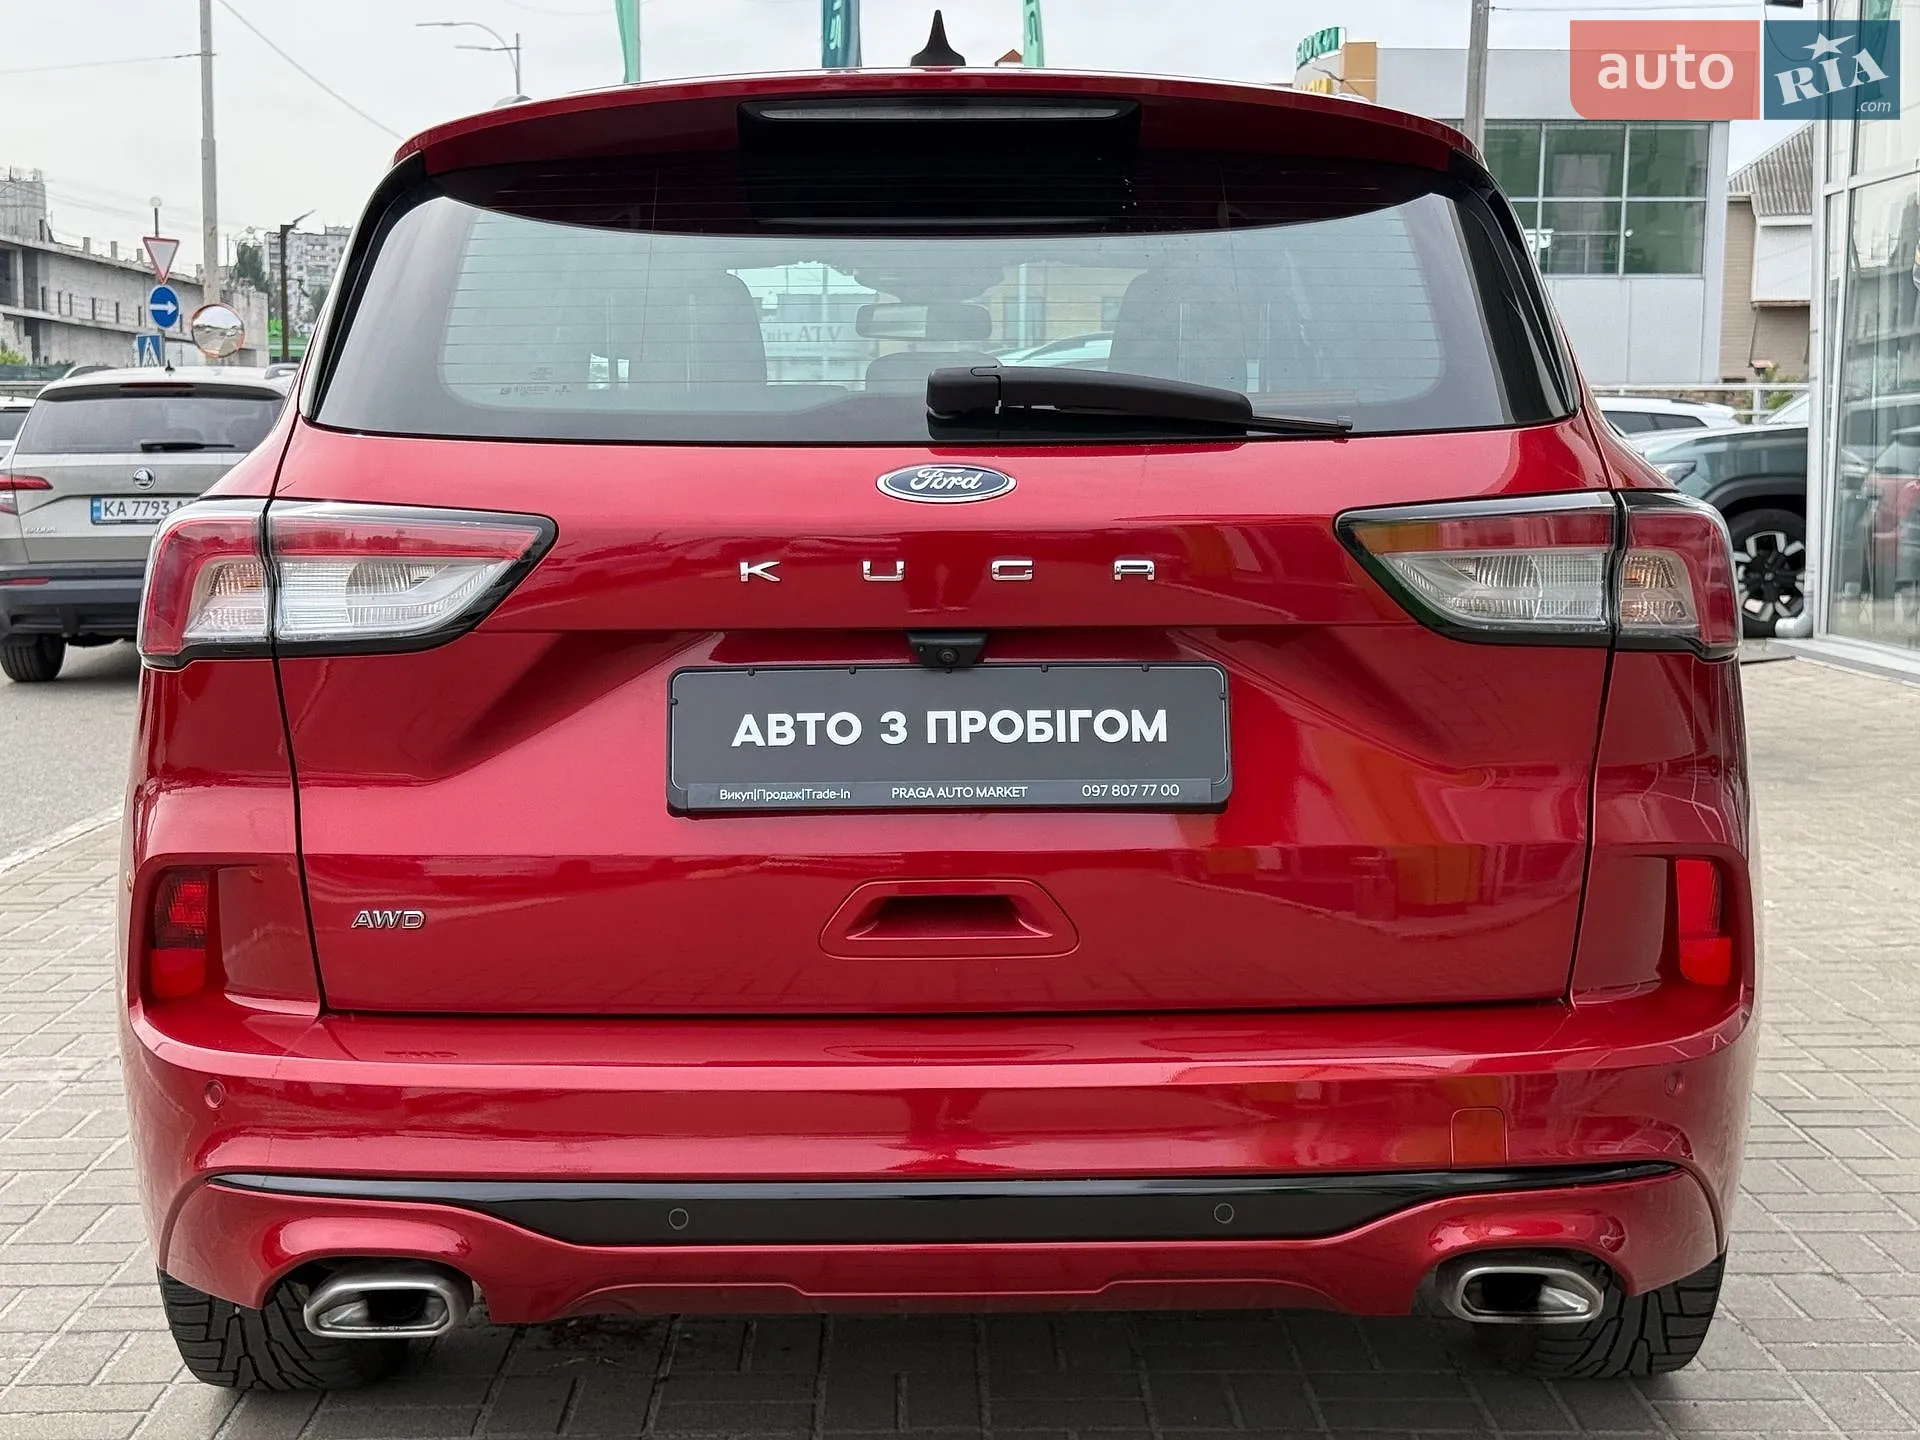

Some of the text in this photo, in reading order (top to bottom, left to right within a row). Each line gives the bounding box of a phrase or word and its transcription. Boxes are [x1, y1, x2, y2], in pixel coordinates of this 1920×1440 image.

[910, 467, 983, 490] Ford
[104, 501, 127, 517] KA
[132, 501, 170, 516] 7793
[739, 559, 1156, 583] KUGA
[731, 708, 1167, 747] АВТО З ПРОБІГОМ
[891, 786, 1028, 799] PRAGA AUTO MARKET
[1082, 784, 1180, 797] 097 807 77 00
[350, 910, 425, 929] AWD
